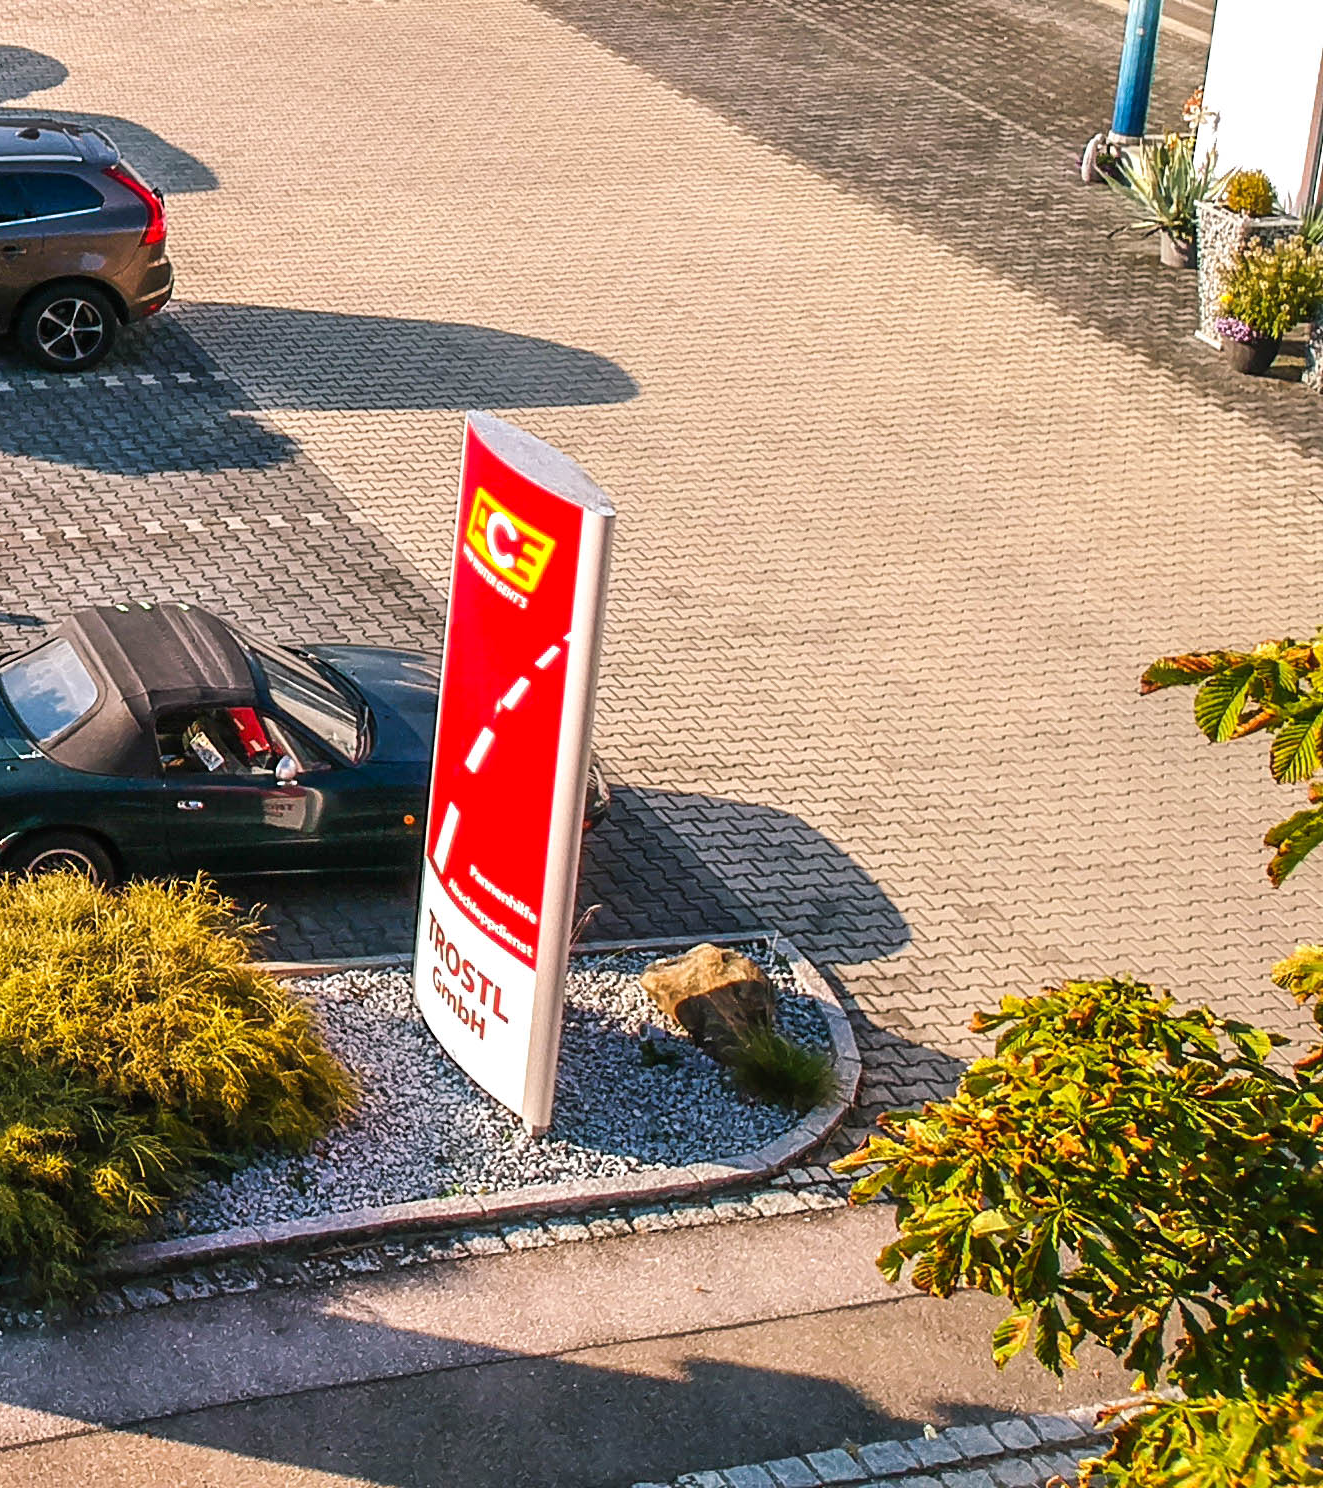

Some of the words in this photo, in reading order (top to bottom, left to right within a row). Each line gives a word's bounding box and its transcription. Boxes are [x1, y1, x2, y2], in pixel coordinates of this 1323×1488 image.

[448, 878, 534, 958] Abschleppdienst
[468, 864, 537, 925] Pannenhilfe
[429, 907, 509, 1024] TROSTL
[432, 965, 486, 1041] GmbH
